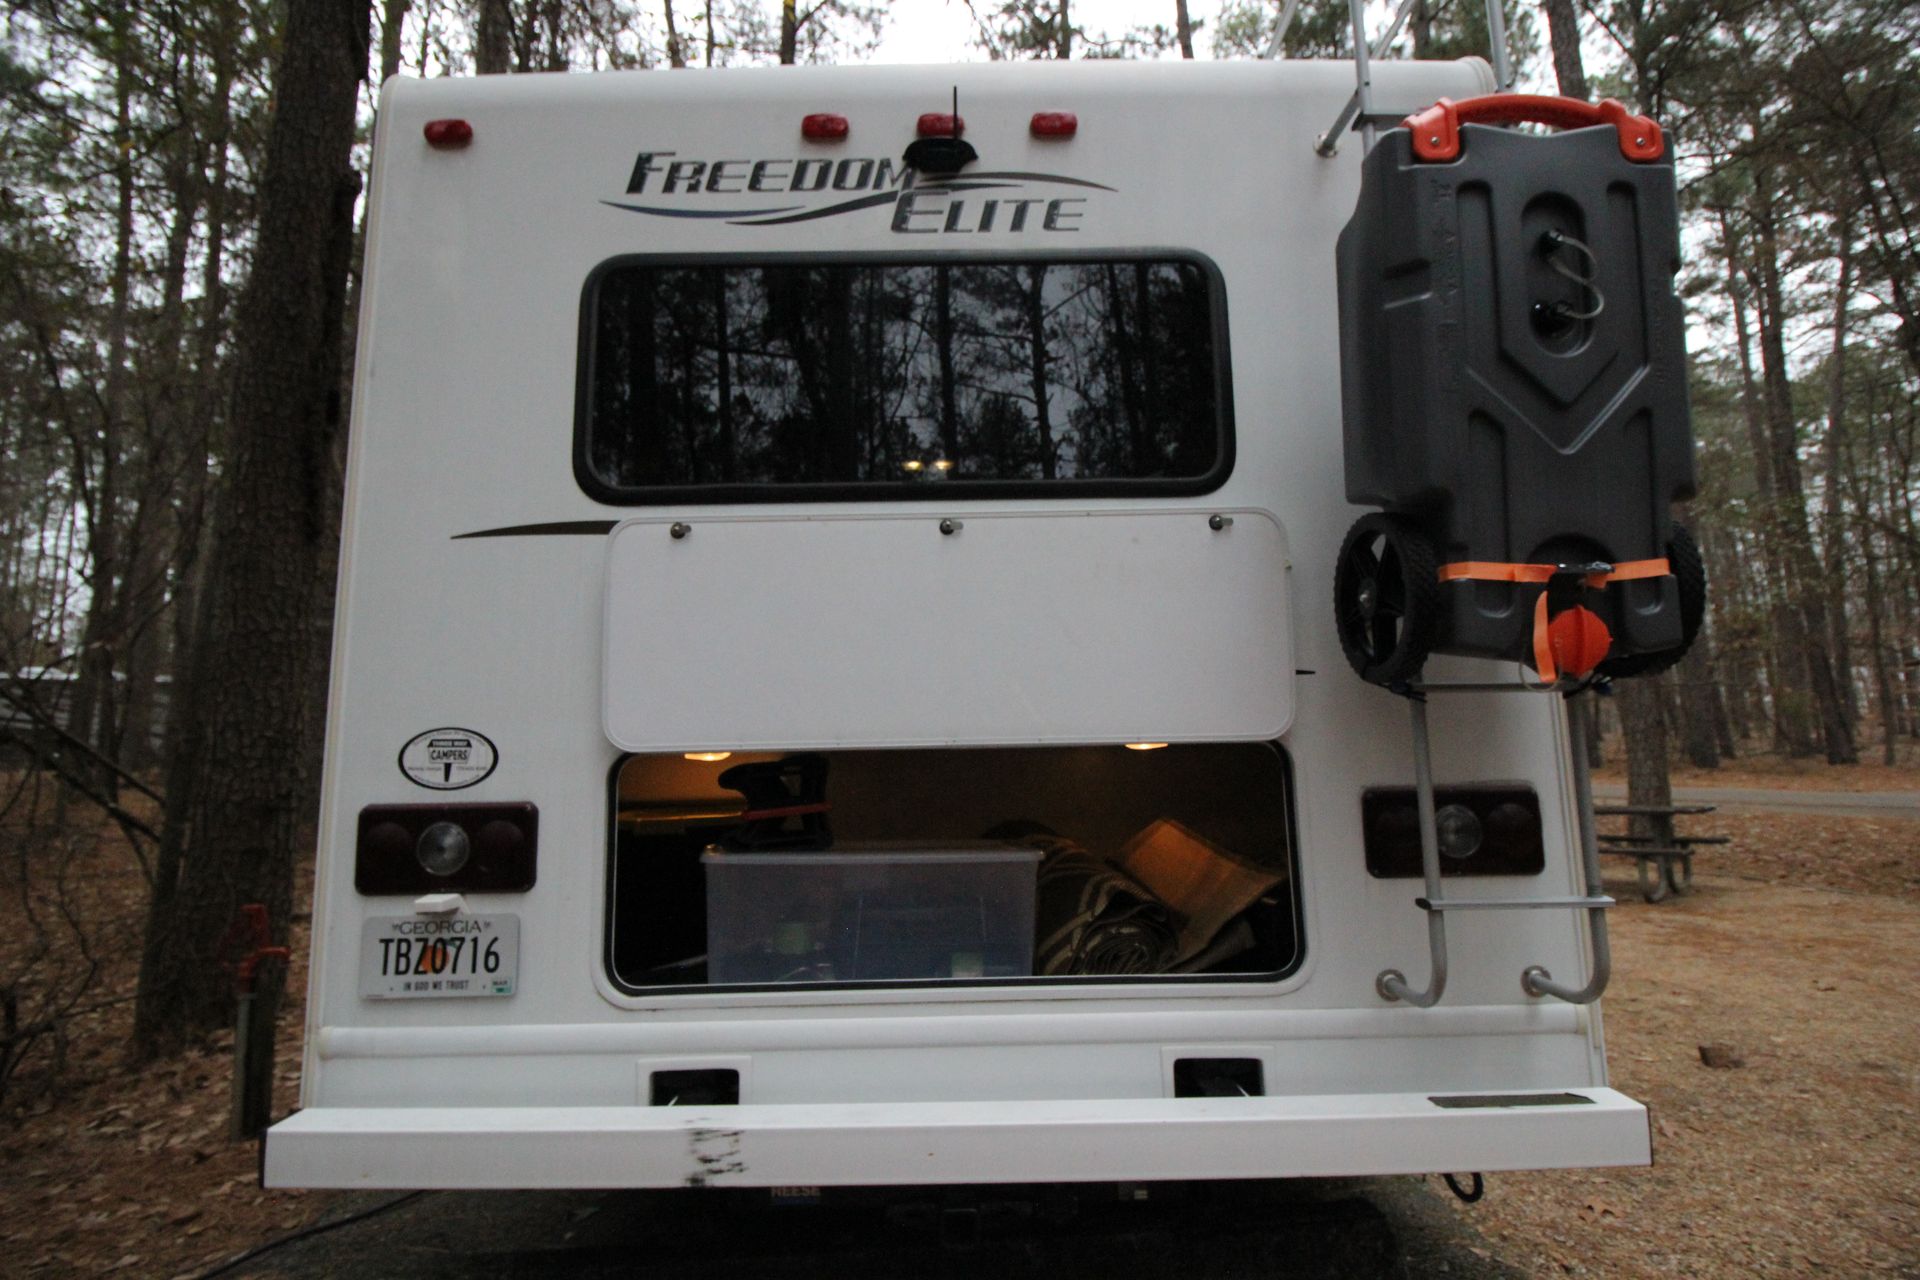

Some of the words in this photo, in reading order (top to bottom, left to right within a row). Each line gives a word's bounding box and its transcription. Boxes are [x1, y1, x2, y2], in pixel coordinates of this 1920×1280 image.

[626, 151, 919, 194] FREEDOM
[890, 189, 1087, 234] ELITE
[431, 749, 467, 760] CAMPERS
[399, 920, 482, 935] GEORGIA
[379, 936, 500, 976] TBZ0716
[403, 982, 411, 991] IN
[414, 982, 429, 991] GOD
[432, 981, 442, 990] WE
[446, 980, 470, 990] TRUST
